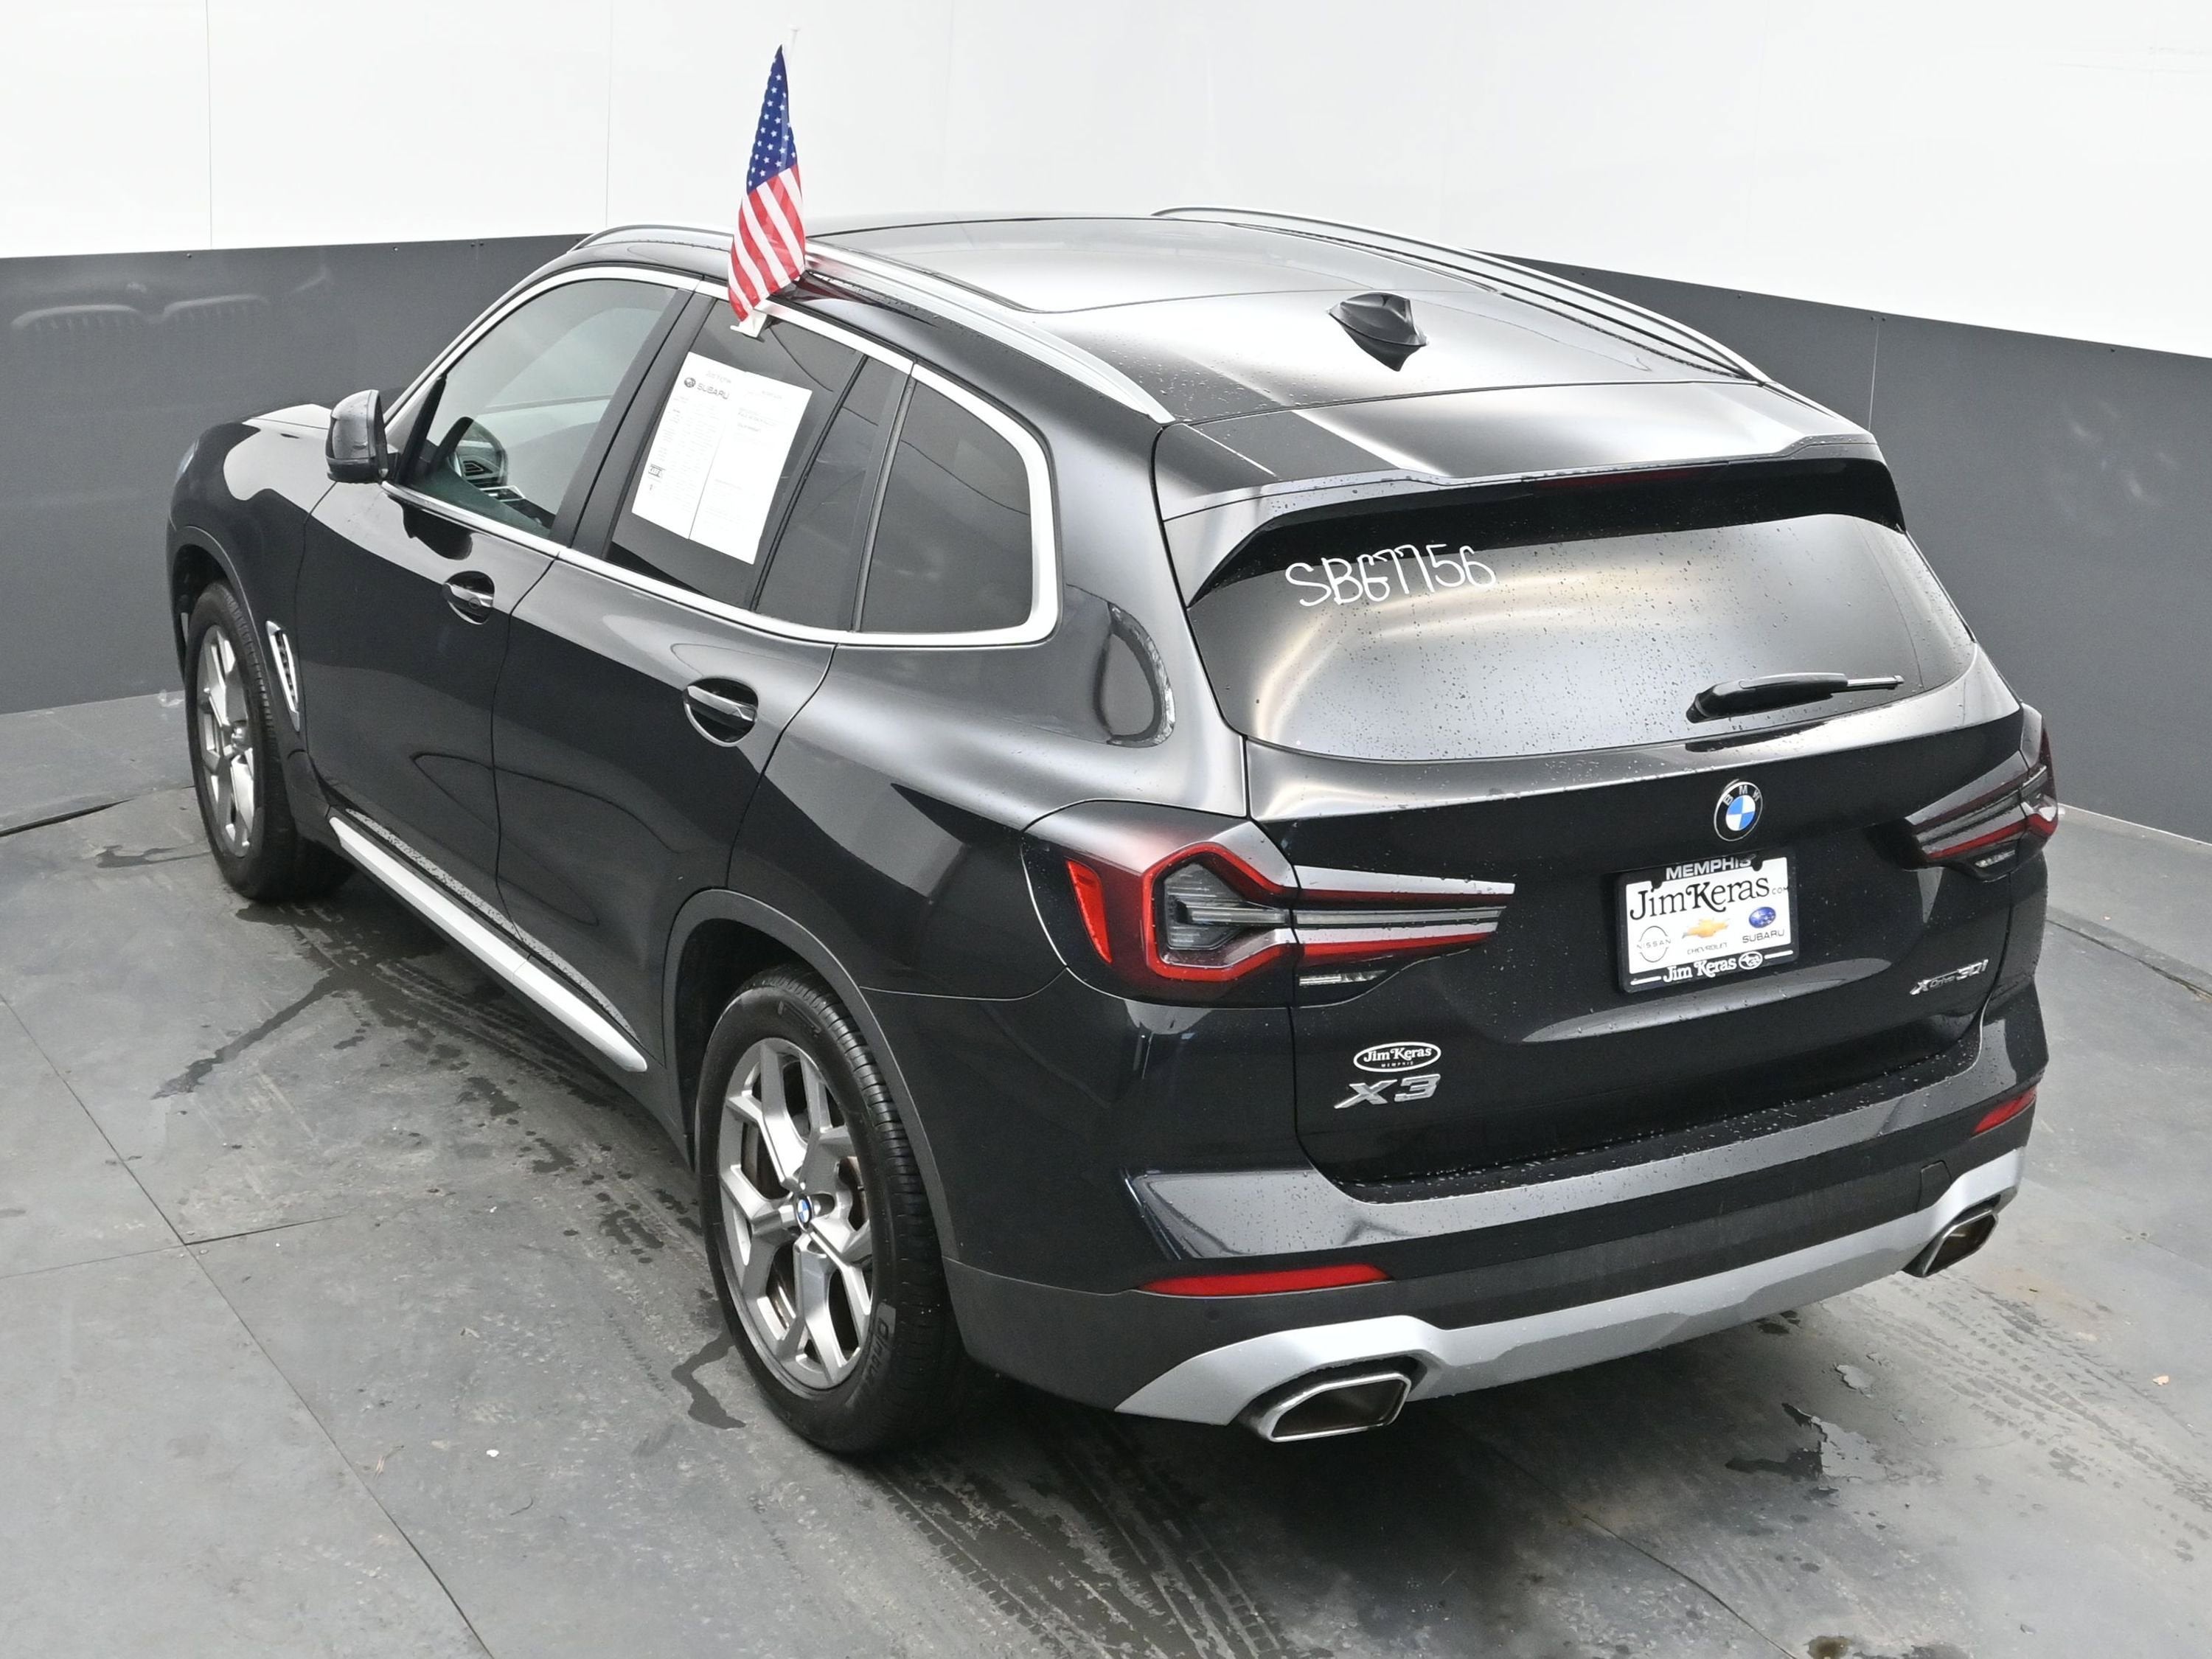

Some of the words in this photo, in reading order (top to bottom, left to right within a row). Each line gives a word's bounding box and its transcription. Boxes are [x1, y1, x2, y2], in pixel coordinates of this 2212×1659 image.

[696, 383, 730, 400] SUBARU
[1722, 785, 1761, 807] BMW
[1666, 856, 1752, 880] MEMPHIS
[1636, 938, 1672, 950] NISSAN
[1742, 930, 1785, 944] SUBARU
[1687, 942, 1728, 956] CHEVROLET
[1663, 964, 1693, 983] Jim
[1694, 957, 1737, 978] Keras
[1334, 1074, 1441, 1109] X3
